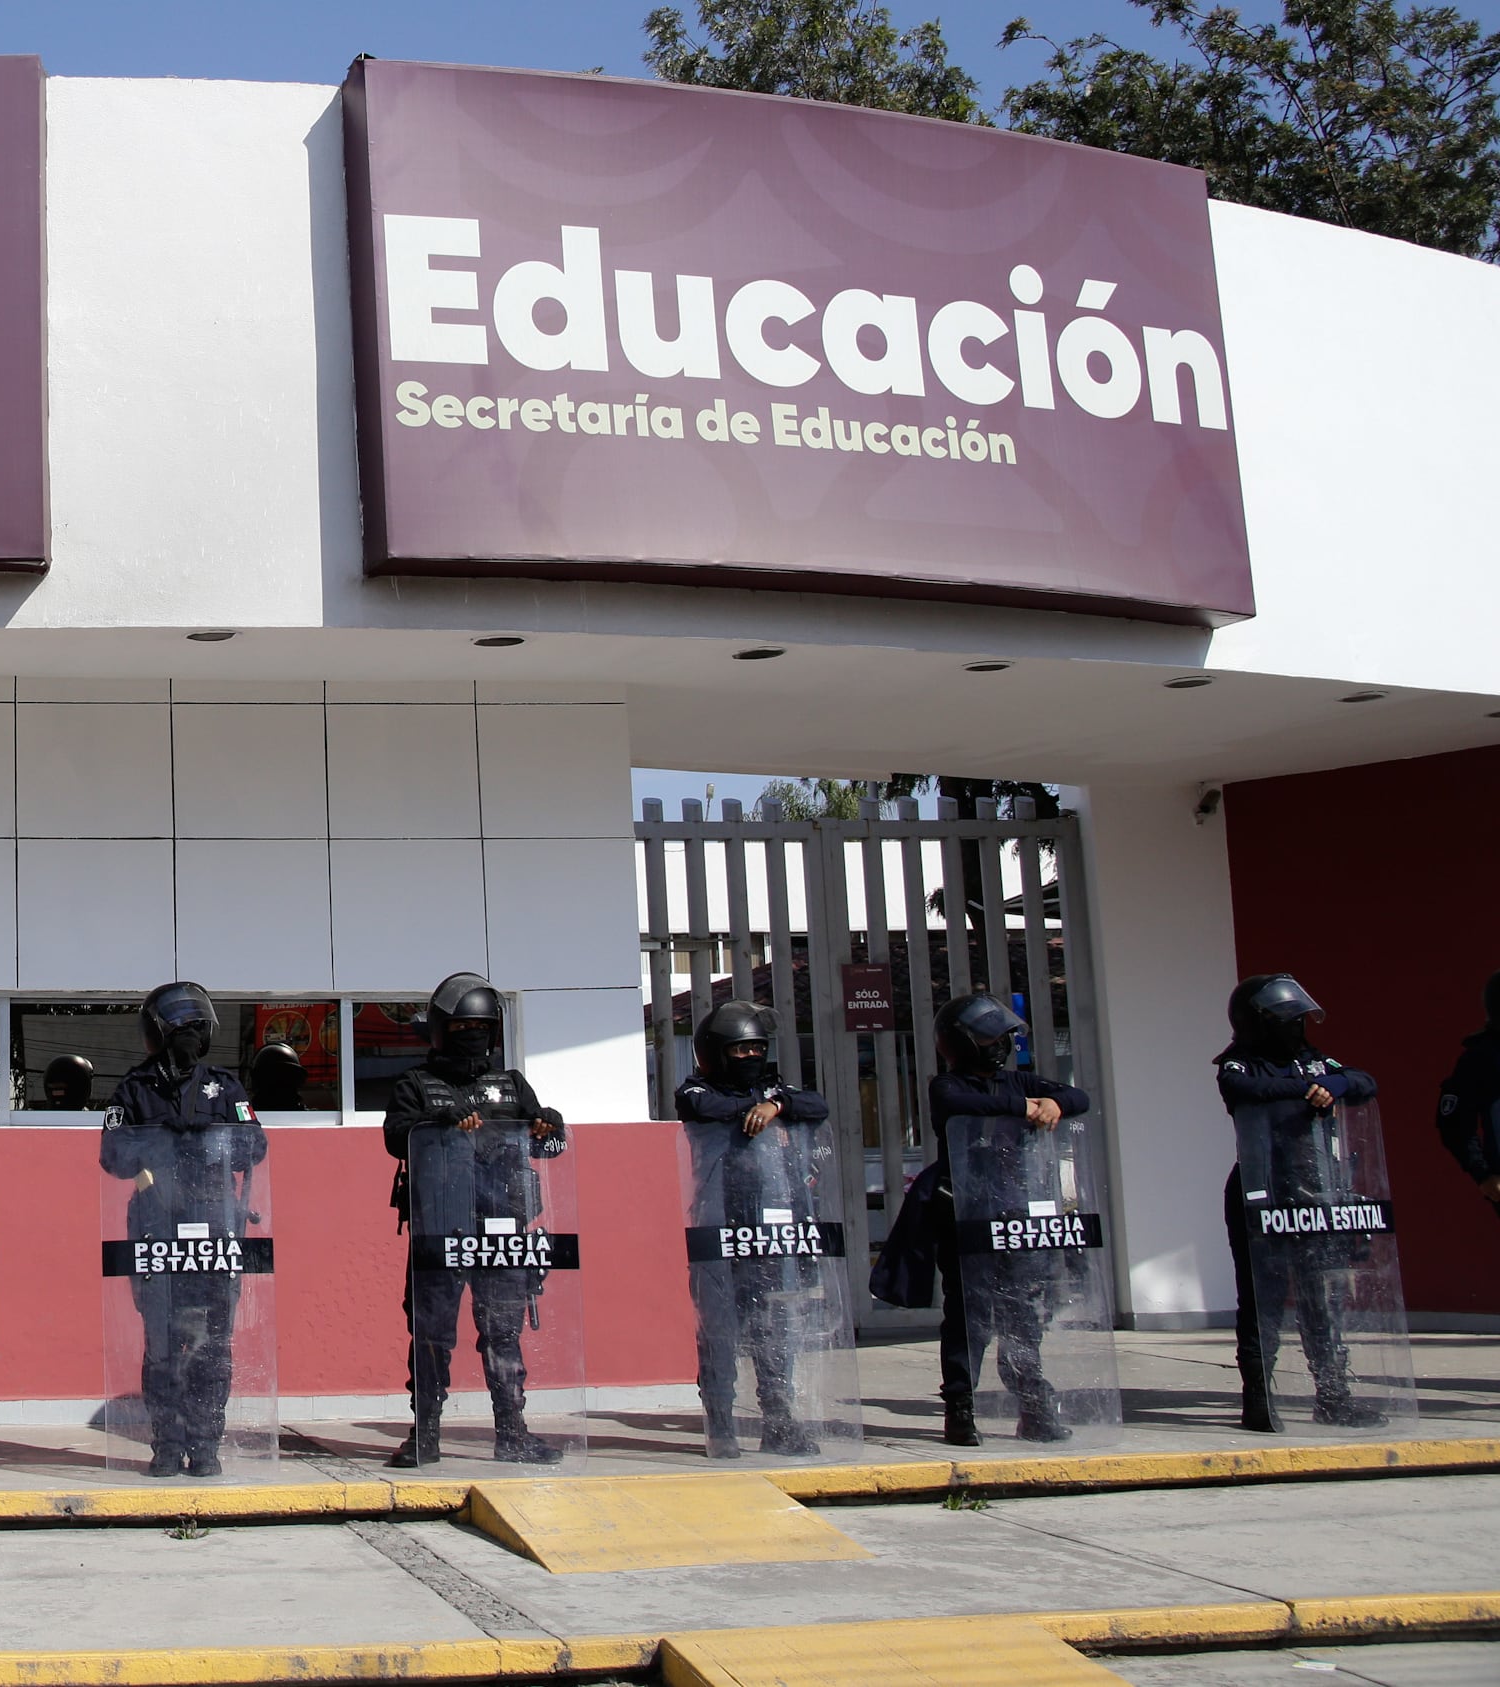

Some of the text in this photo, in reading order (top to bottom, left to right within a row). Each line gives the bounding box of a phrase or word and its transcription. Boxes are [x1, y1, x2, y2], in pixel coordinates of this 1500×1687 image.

[383, 213, 1229, 430] Educación
[395, 380, 1018, 465] Secretaría de Educación
[855, 988, 880, 999] SÓLO
[847, 1000, 890, 1010] ENTRADA
[990, 1215, 1085, 1236] POLICÍA
[1260, 1204, 1387, 1234] POLICIA ESTATAL
[719, 1223, 821, 1242] POLICÍA
[991, 1231, 1086, 1250] ESTATAL
[134, 1239, 243, 1257] POLICÍA
[444, 1234, 551, 1252] POLICÍA
[720, 1240, 823, 1258] ESTATAL
[135, 1256, 244, 1273] ESTATAL
[445, 1251, 552, 1267] ESTATAL
